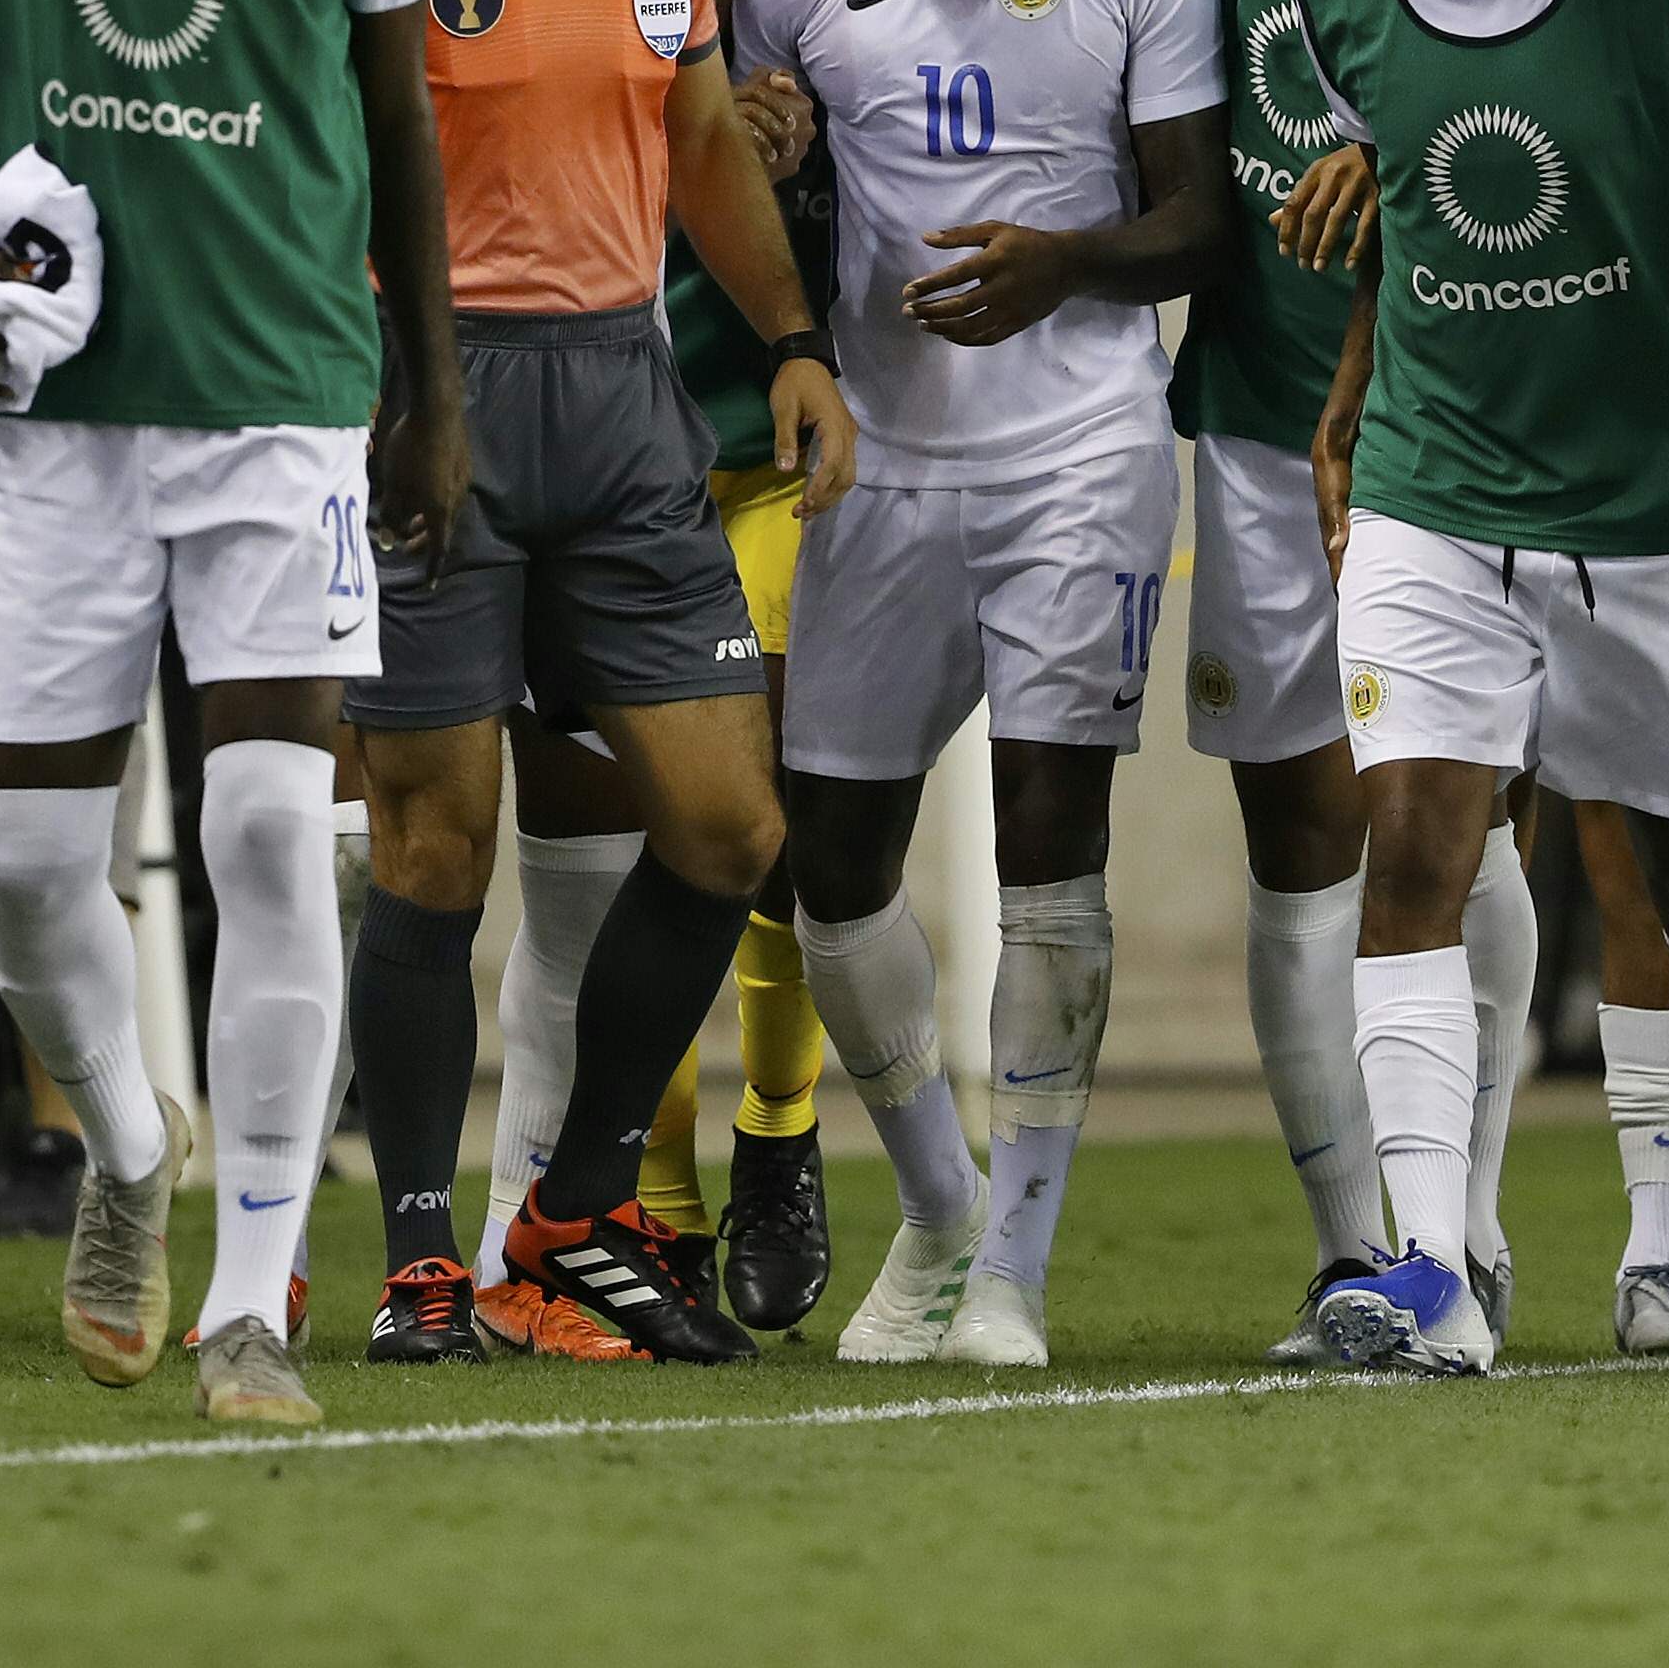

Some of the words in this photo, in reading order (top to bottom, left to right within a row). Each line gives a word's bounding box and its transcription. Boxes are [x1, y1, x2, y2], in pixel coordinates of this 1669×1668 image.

[640, 1, 687, 16] REFEREE
[41, 78, 263, 148] Concacaf
[917, 63, 994, 157] 10
[1411, 256, 1632, 312] Concacaf
[715, 630, 760, 662] savi
[1115, 572, 1160, 673] 10
